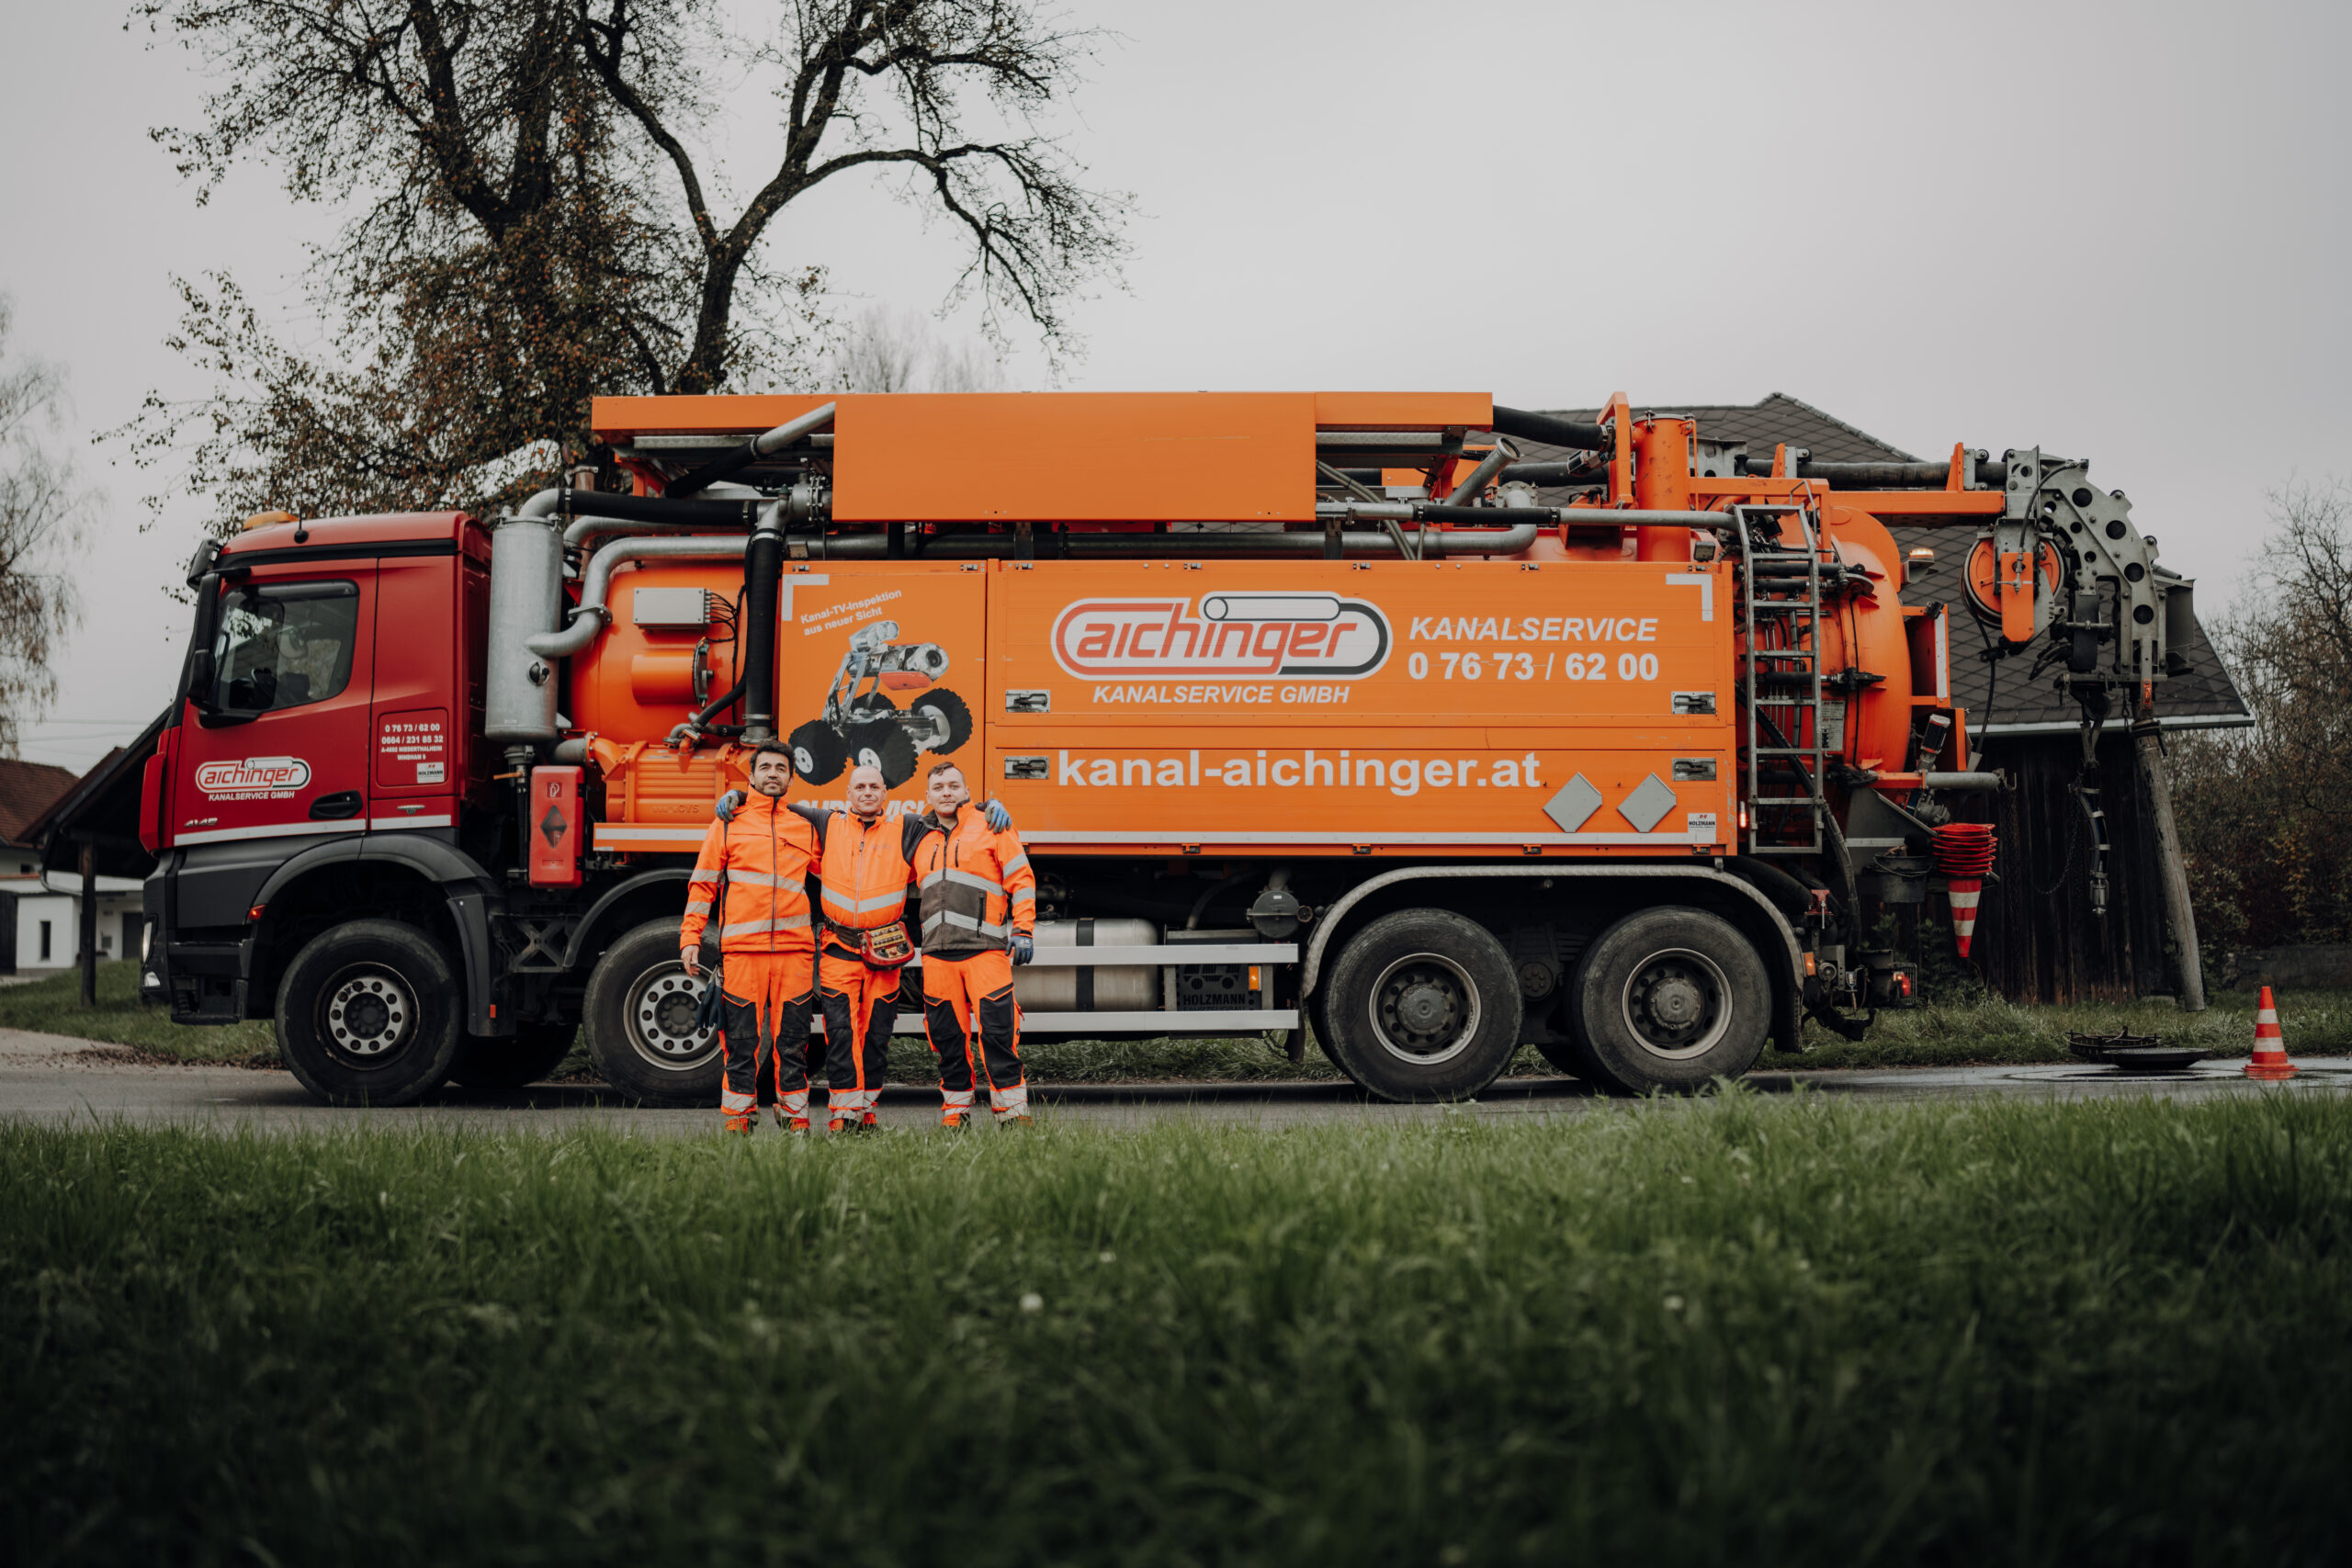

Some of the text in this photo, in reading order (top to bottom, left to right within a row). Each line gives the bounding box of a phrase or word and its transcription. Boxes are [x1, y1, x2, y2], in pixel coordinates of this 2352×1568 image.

[800, 590, 902, 625] Kanal-TV-Inspektion
[804, 607, 883, 637] aus neuer Sicht
[1409, 616, 1658, 641] KANALSERVICE
[1076, 603, 1358, 675] aichinger
[1408, 651, 1659, 681] 0 76 73 / 62 00
[1092, 685, 1350, 704] KANALSERVICE GMBH
[385, 724, 390, 733] 0
[403, 724, 413, 732] 73
[419, 724, 429, 732] 62
[430, 723, 440, 731] 00
[204, 763, 299, 788] aichinger
[1057, 750, 1542, 796] kanal-aichinger.at
[209, 792, 268, 801] KANALSERVICE
[1182, 993, 1246, 1006] HOLZMANN
